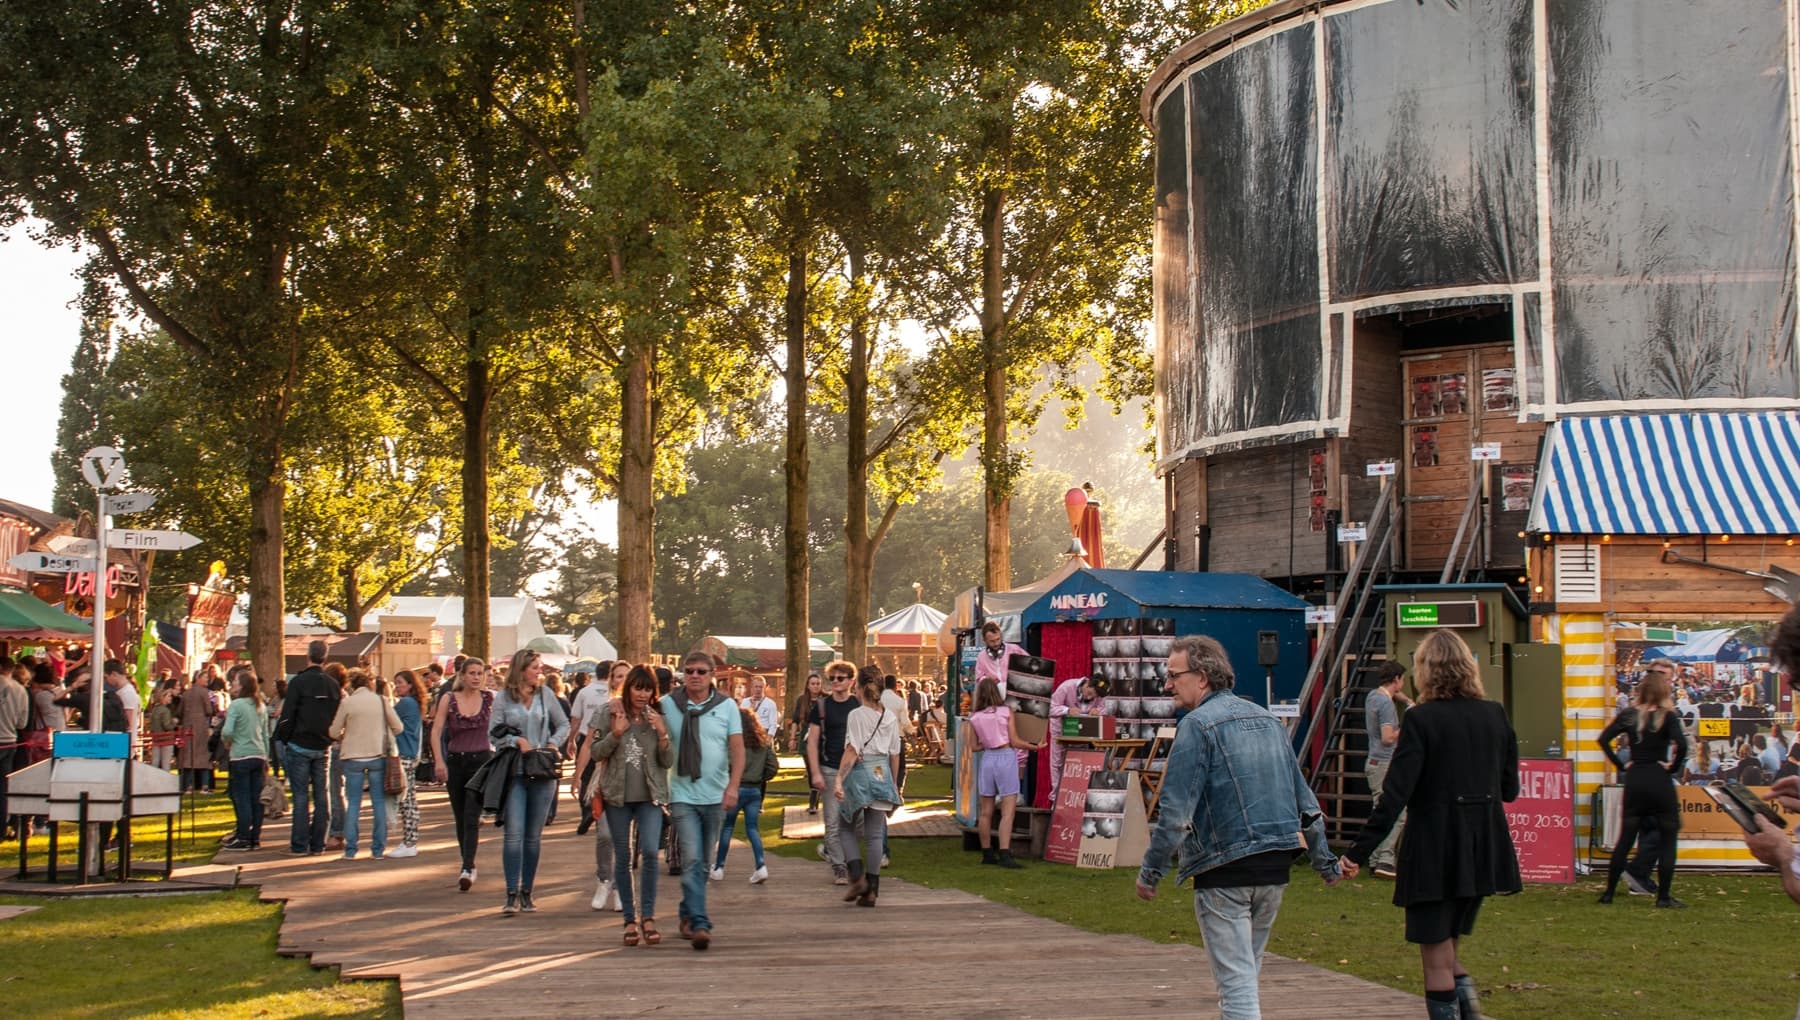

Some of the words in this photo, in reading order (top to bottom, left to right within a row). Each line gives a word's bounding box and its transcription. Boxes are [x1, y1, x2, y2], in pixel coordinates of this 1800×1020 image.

[86, 456, 120, 485] V
[124, 532, 158, 546] Film
[40, 556, 80, 571] Design
[1049, 592, 1108, 609] MINEAC
[1518, 770, 1570, 800] HEN!
[1081, 852, 1112, 868] MINEAC
